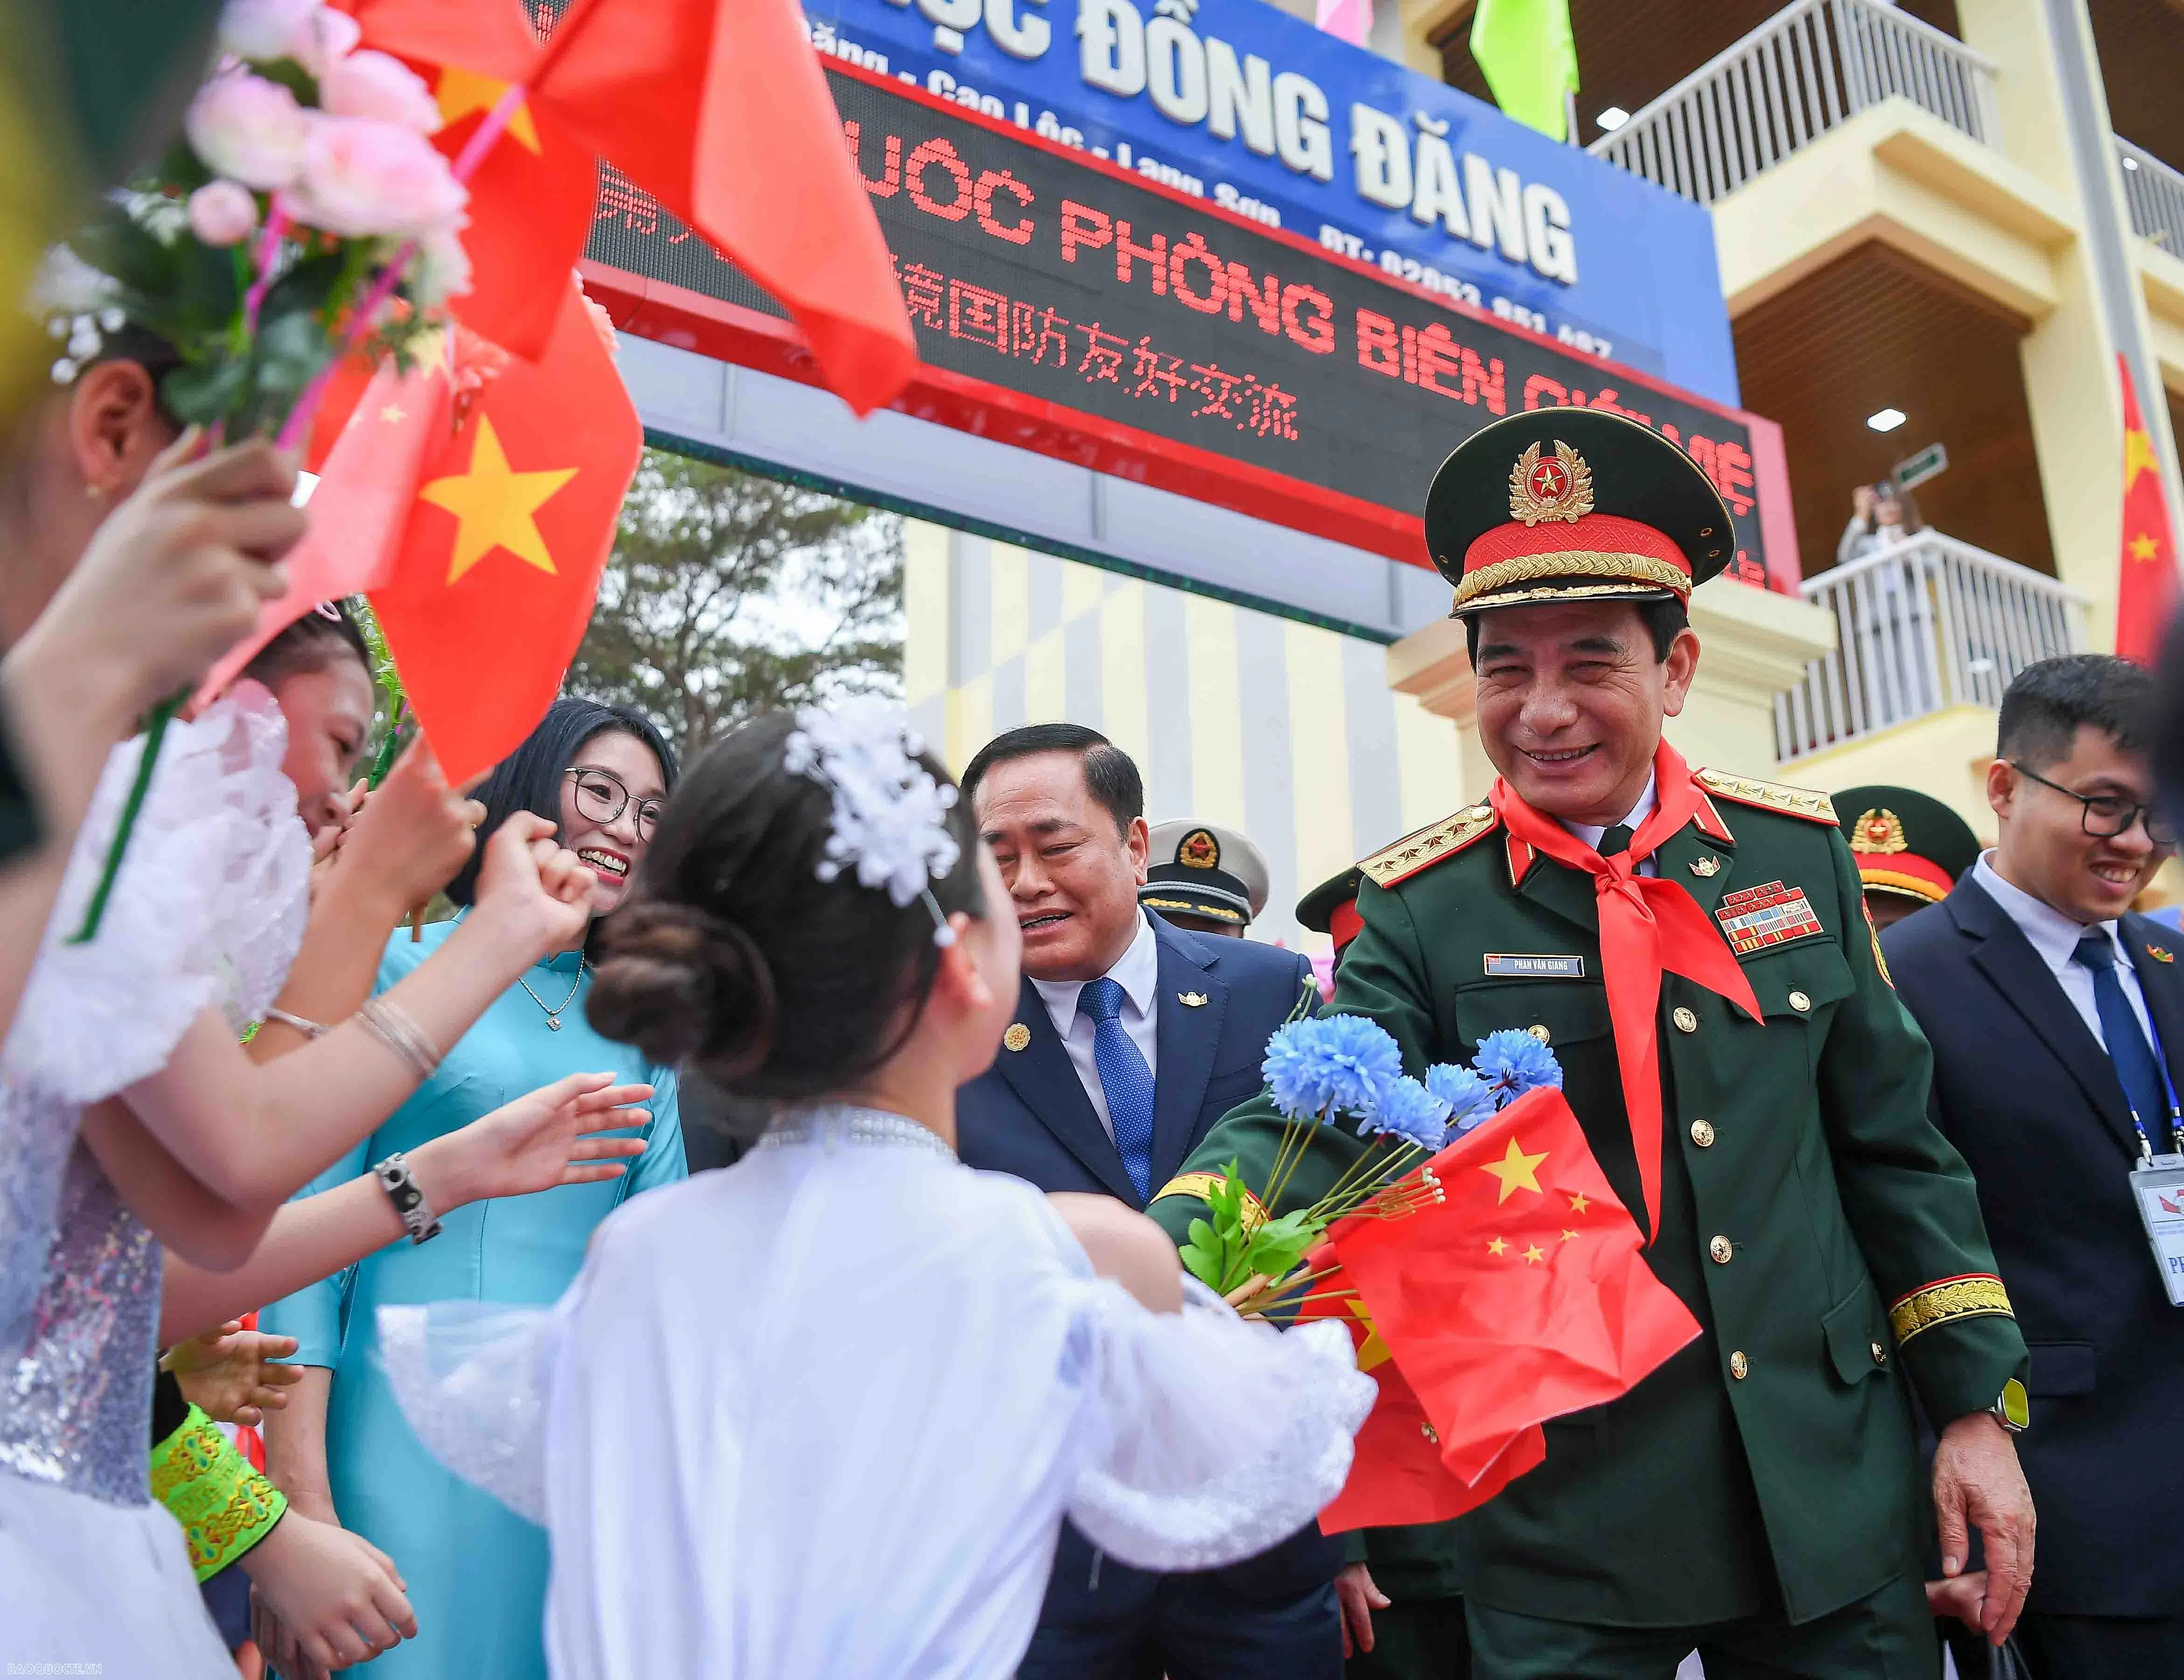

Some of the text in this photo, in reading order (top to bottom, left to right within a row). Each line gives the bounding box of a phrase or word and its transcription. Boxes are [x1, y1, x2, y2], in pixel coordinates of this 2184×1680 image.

[1351, 101, 1579, 286] ĐĂNG
[1061, 199, 1335, 354] PHÒNG
[1356, 307, 1507, 415] BIÊN
[1514, 960, 1531, 970] PHAN
[1547, 960, 1568, 971] GIANG
